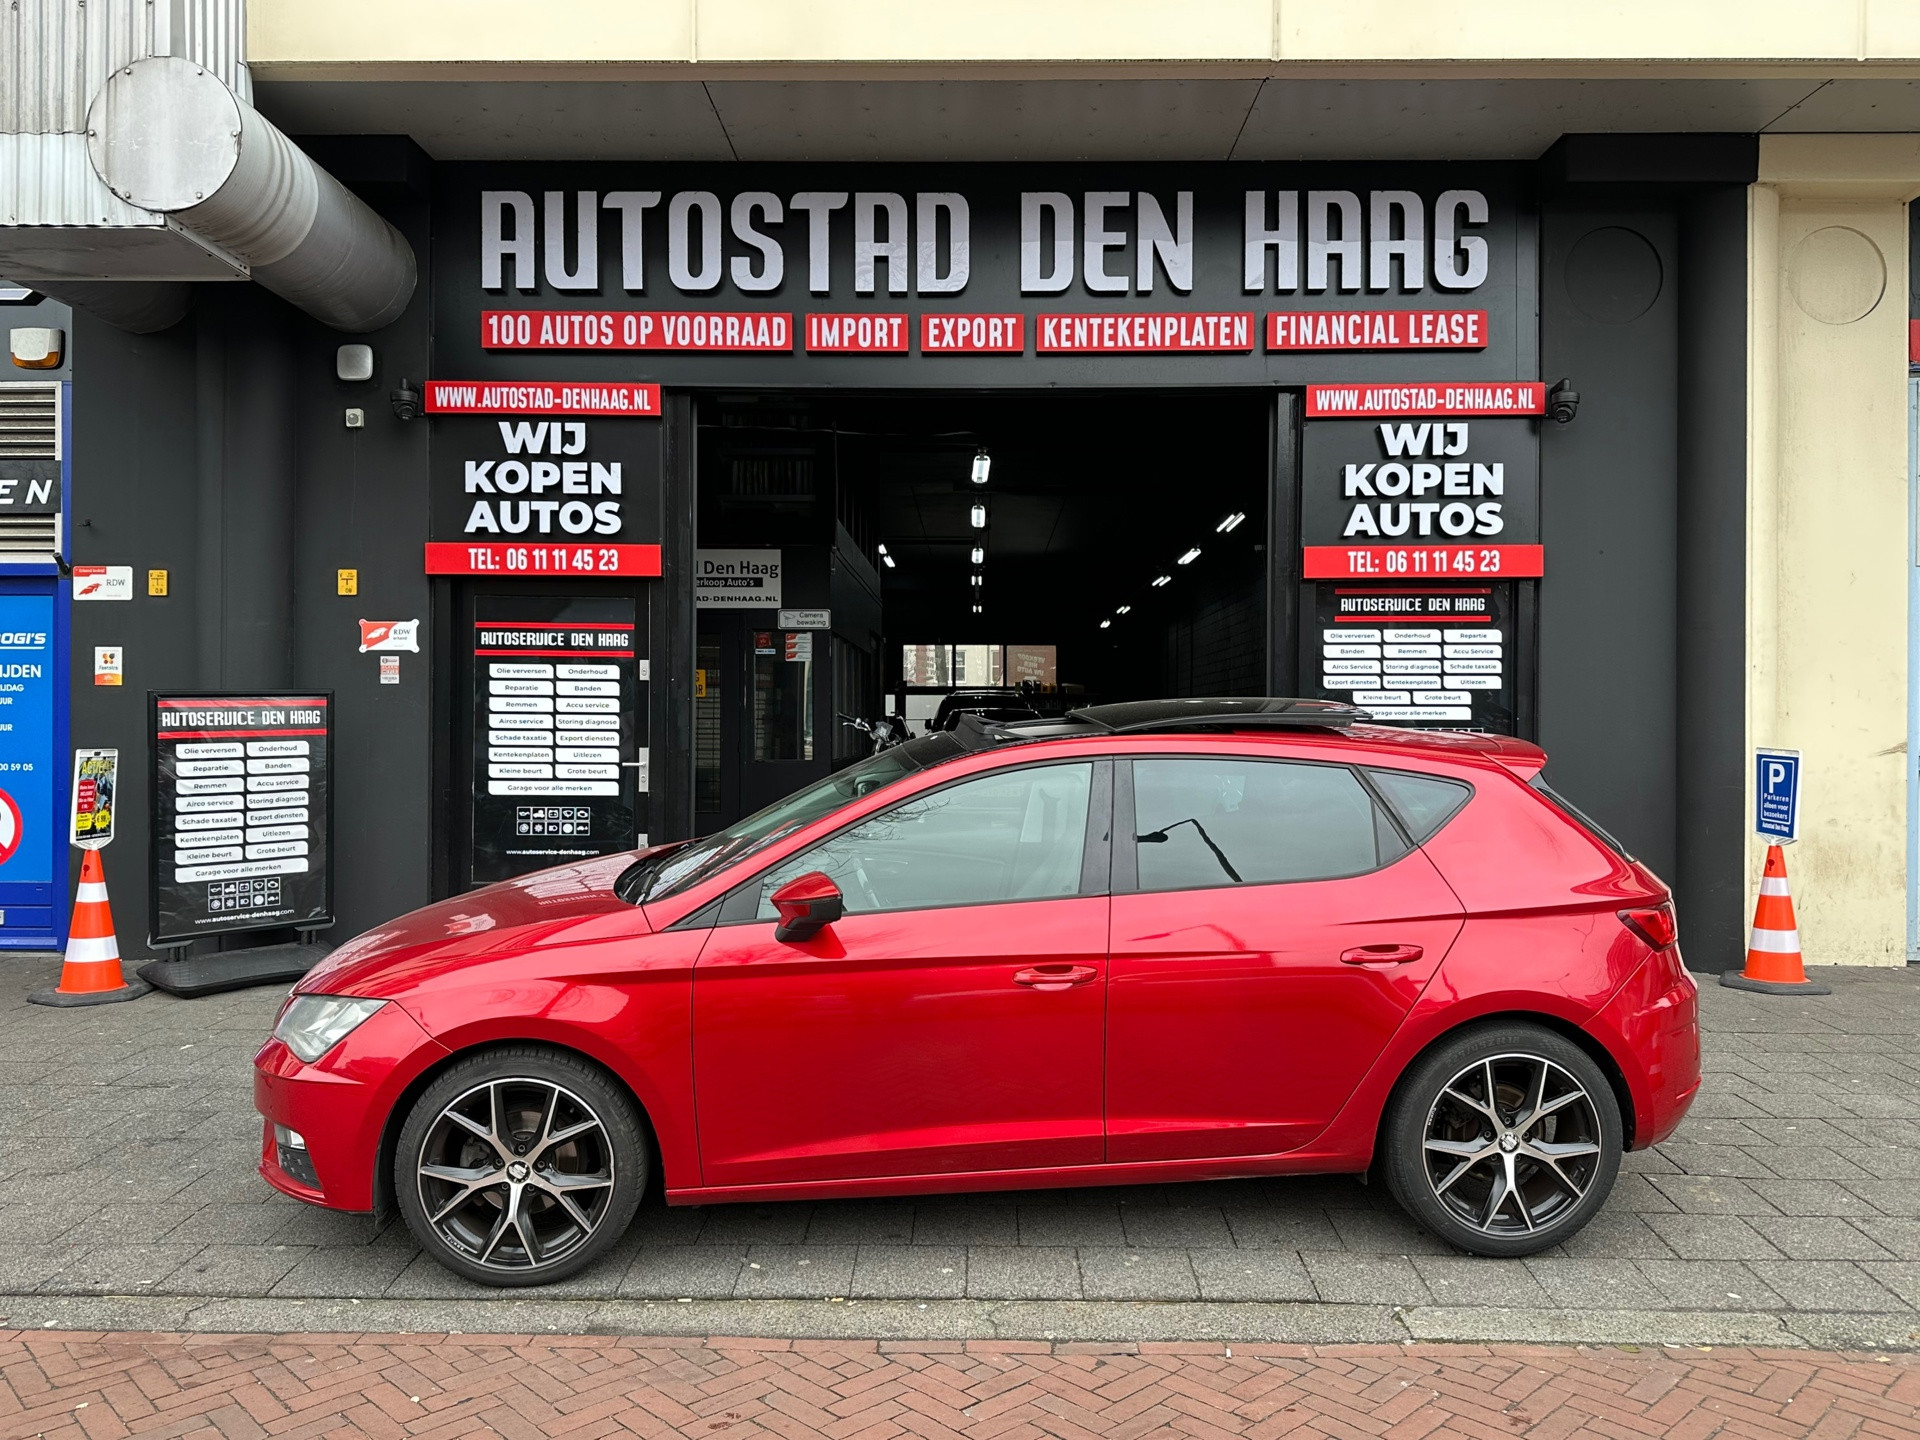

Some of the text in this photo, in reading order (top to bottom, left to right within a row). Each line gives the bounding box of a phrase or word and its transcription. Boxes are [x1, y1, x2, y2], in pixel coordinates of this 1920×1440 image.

[481, 189, 1490, 294] AUTOSTAD DEN HAAG
[488, 315, 787, 348] 100 AUTOS OP VOORRAAD
[811, 317, 901, 348] IMPORT
[928, 317, 1016, 348] EXPORT
[1043, 315, 1248, 348] KENTEKENPLATEN
[1276, 313, 1479, 346] FINANCIAL LEASE
[434, 386, 651, 411] WWW.AUTOSTAD-DENHAAG.NL
[1315, 388, 1536, 411] WWW.AUTOSTAD-DENHAAG.NL
[498, 421, 587, 455] WIJ
[1378, 423, 1469, 456] WIJ
[464, 461, 622, 495] KOPEN
[1344, 463, 1504, 497] KOPEN
[463, 501, 622, 535] AUTOS
[1343, 502, 1504, 537] AUTOS
[468, 548, 619, 571] TEL: 06 11 11 45 23
[703, 560, 735, 575] Den
[740, 560, 779, 578] Haag
[1347, 550, 1501, 573] TEL: 06 11 11 45 23
[106, 578, 125, 586] RDW
[727, 578, 754, 587] Auto's
[1340, 598, 1486, 612] AUTOSERVICE DEN HAAG
[0, 633, 47, 644] OGI'S
[480, 631, 629, 647] AUTOSERVICE DEN HAAG
[161, 710, 320, 727] AUTOSERVICE DEN HAAG
[10, 763, 20, 771] 59
[22, 763, 33, 771] 05
[192, 764, 229, 772] Reparatie
[1768, 762, 1786, 794] P
[248, 796, 306, 806] Storing diagnose
[1764, 792, 1790, 802] Parkeren
[250, 812, 304, 823] Export diensten
[1764, 810, 1788, 820] bezoekers
[180, 834, 239, 844] Kentekenplaten
[196, 870, 222, 878] Garage
[254, 864, 282, 872] merken
